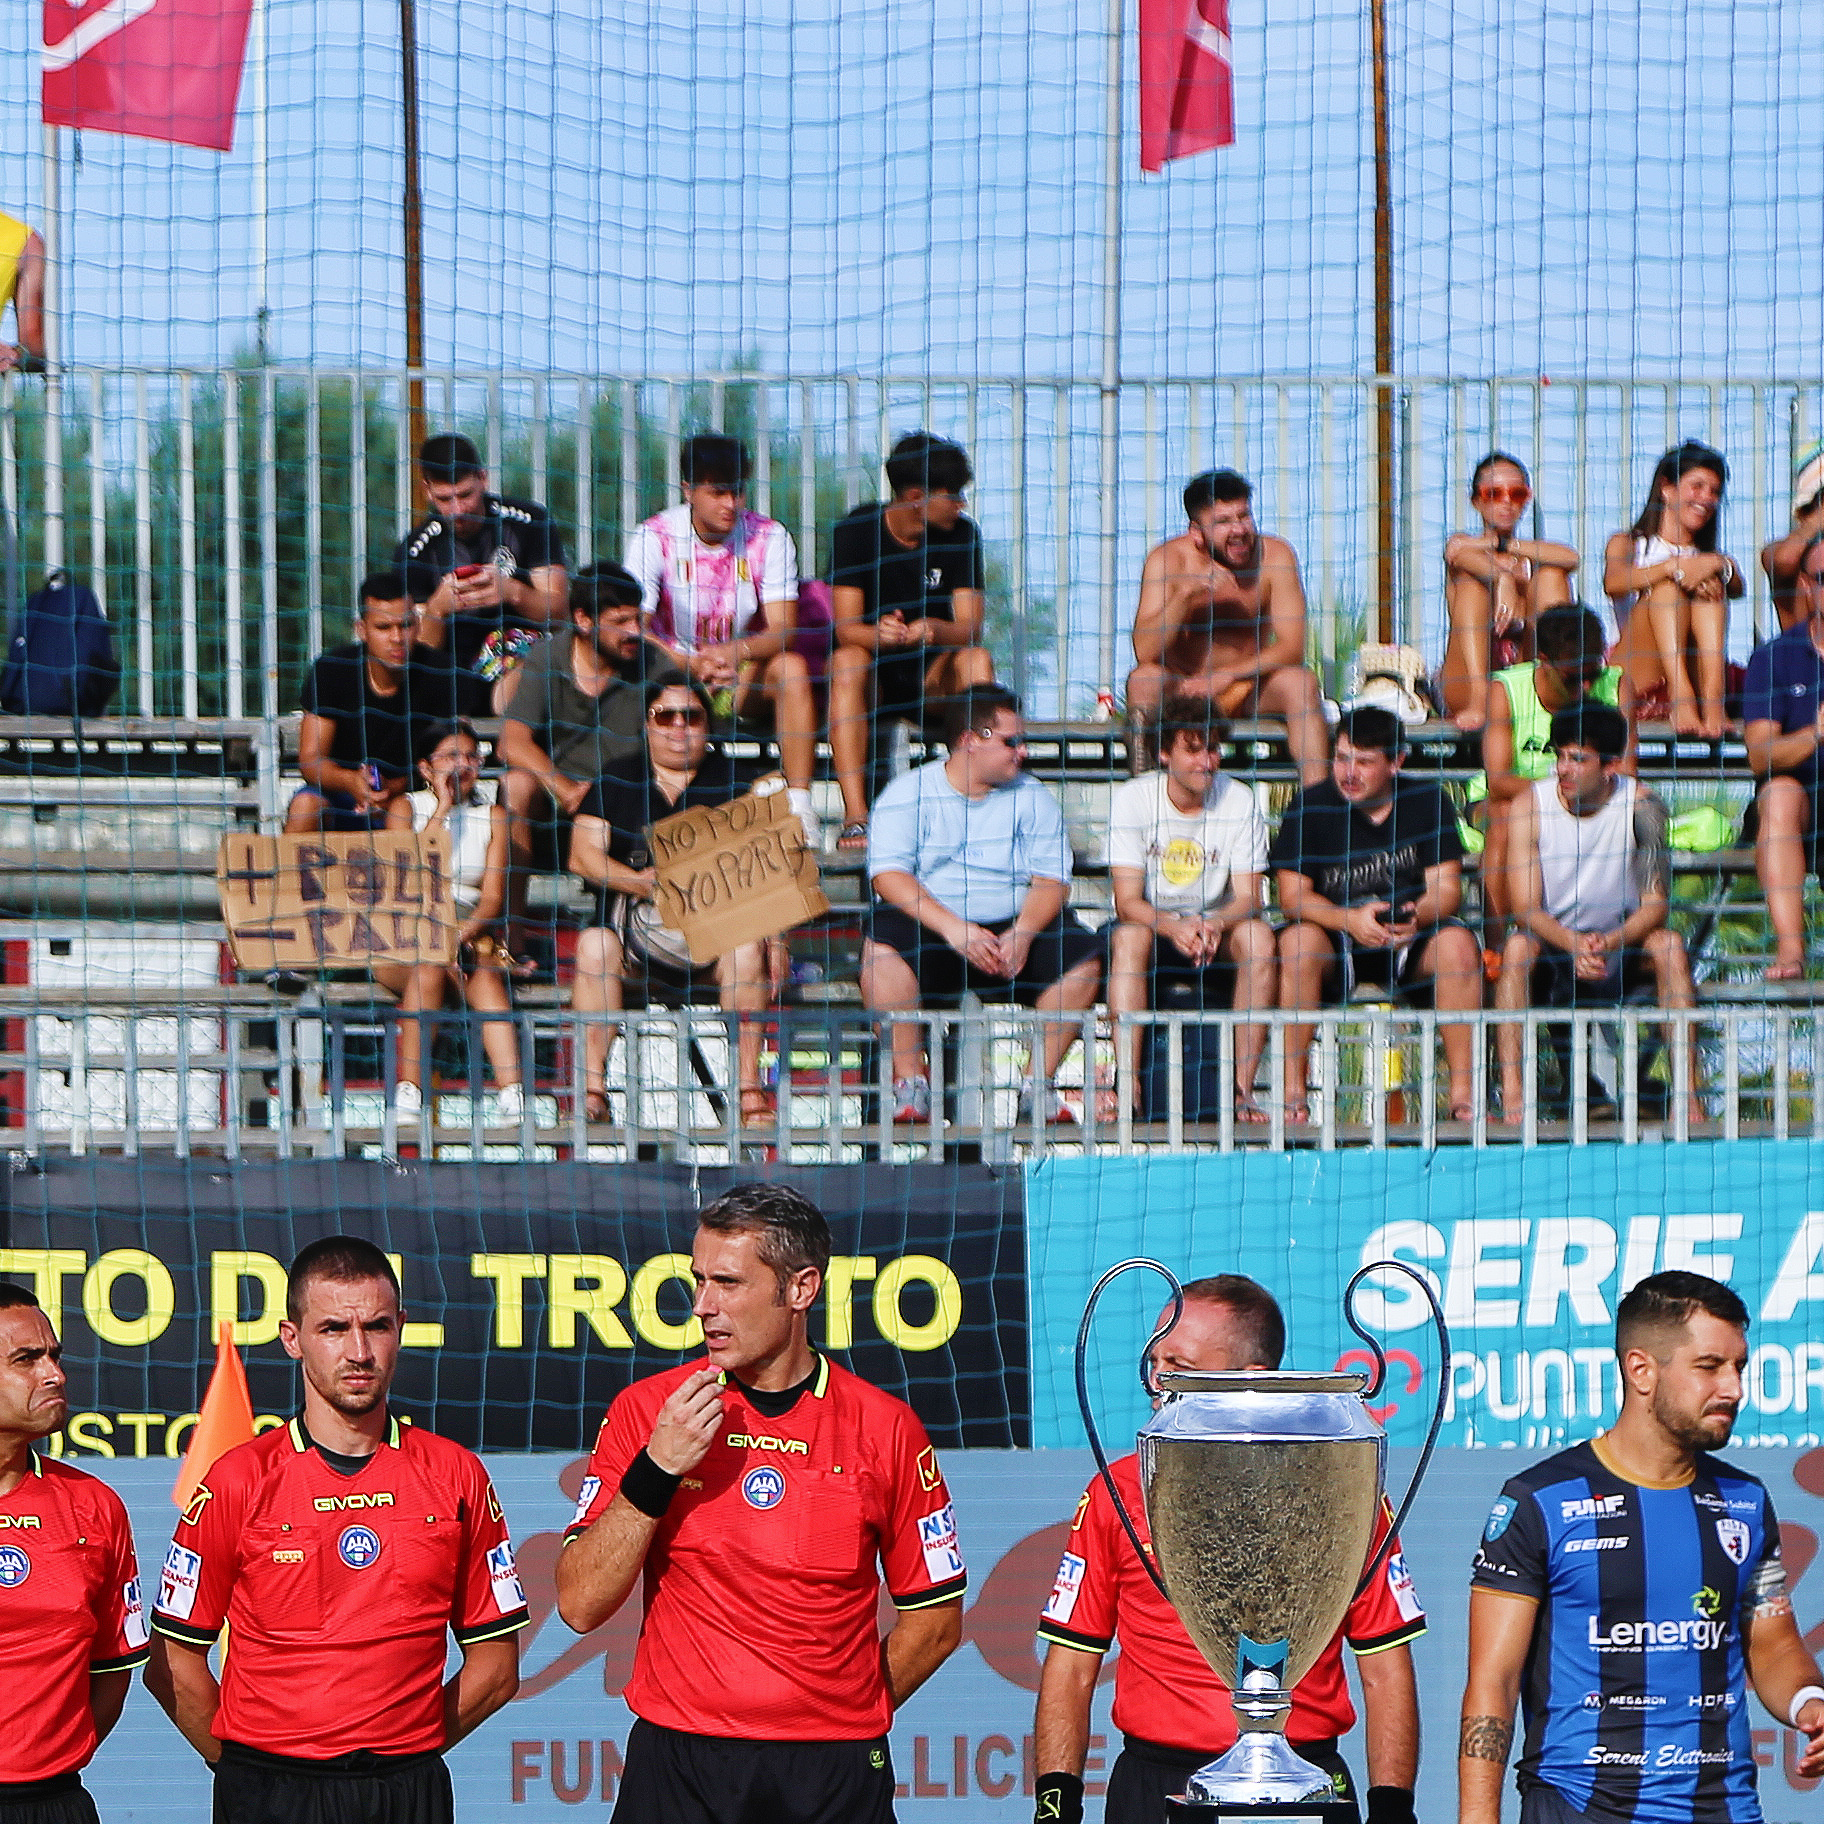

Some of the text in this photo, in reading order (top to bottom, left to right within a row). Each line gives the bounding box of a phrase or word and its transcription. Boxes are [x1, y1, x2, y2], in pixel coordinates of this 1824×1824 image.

[211, 1250, 444, 1348] DL
[472, 1252, 963, 1353] TROTO
[727, 1433, 808, 1455] GIVOVA
[314, 1493, 395, 1512] GIVOVA
[1565, 1536, 1629, 1552] GEMS
[1588, 1614, 1726, 1650] Lenergy
[1583, 1746, 1649, 1766] Sereni
[511, 1736, 627, 1804] FUN
